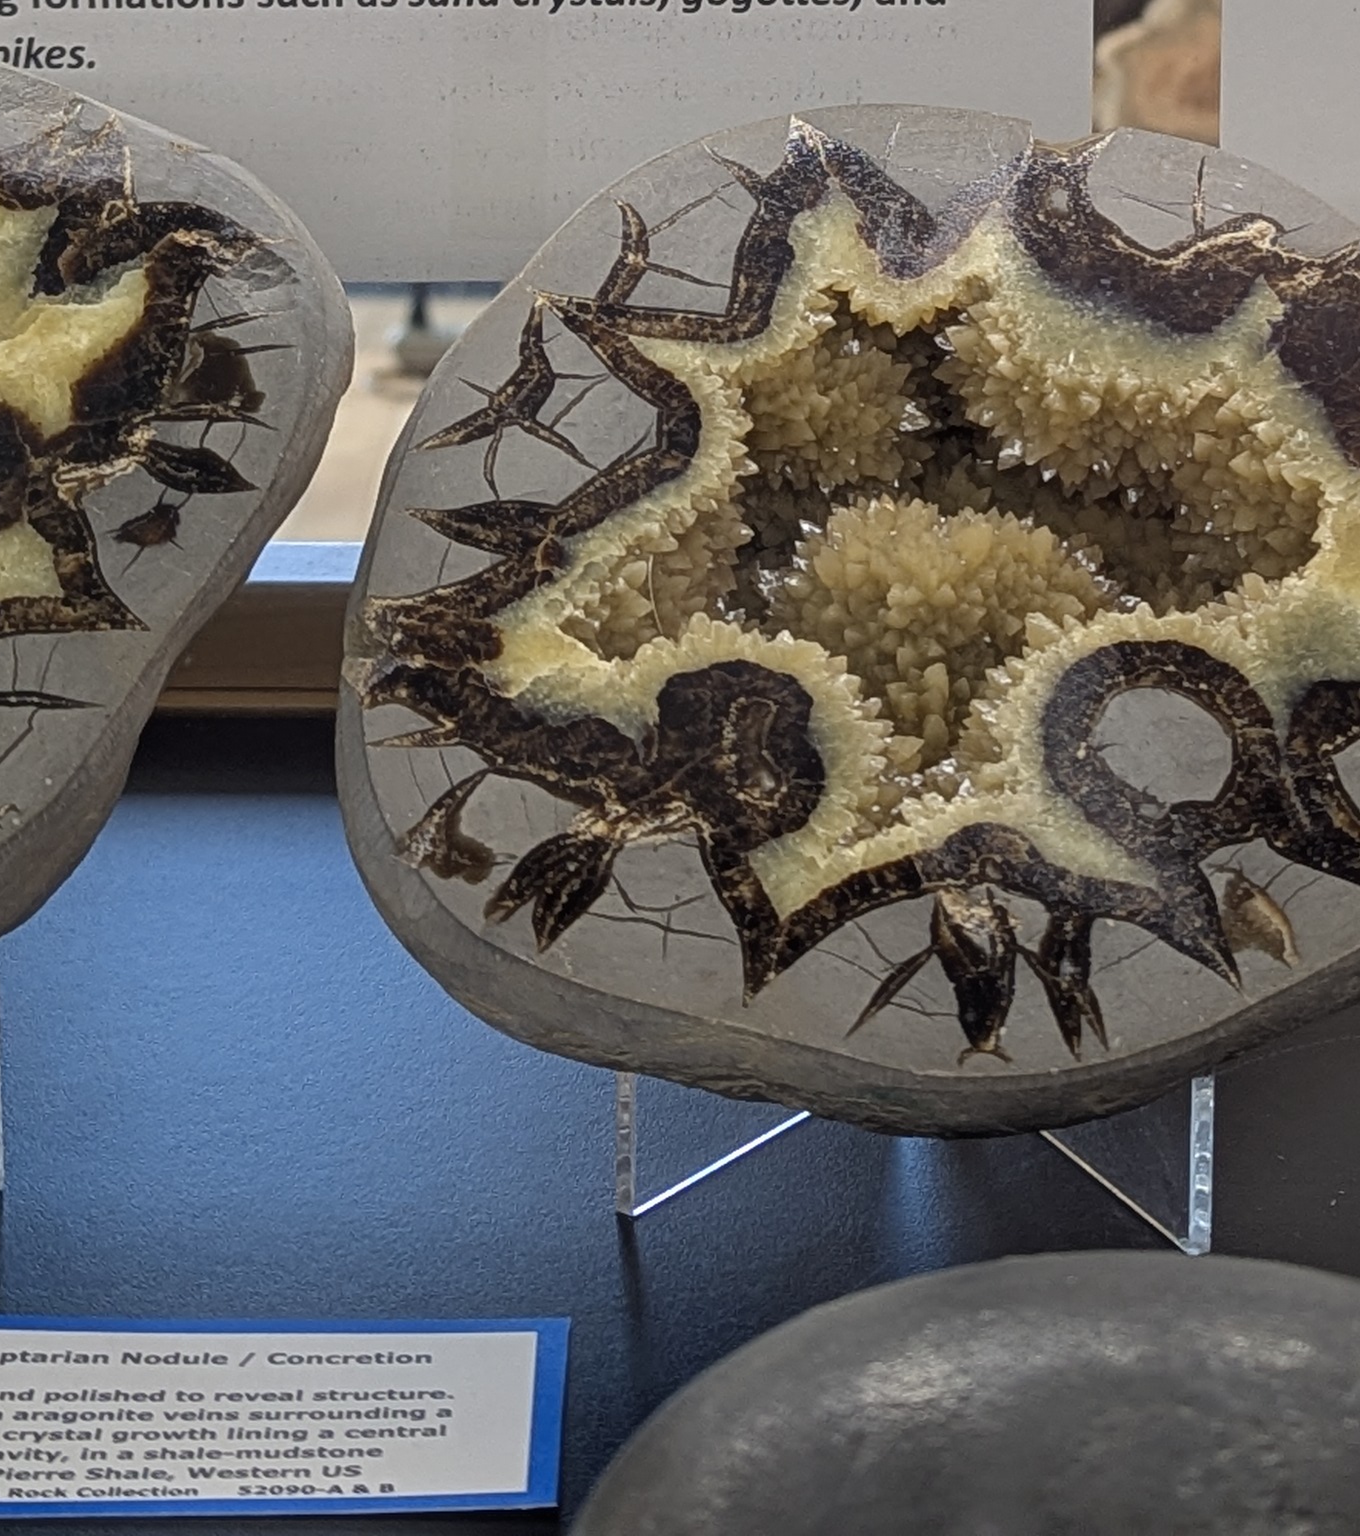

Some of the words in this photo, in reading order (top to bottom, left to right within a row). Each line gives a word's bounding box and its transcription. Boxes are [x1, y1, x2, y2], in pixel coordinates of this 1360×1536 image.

[122, 1353, 228, 1364] Nodule
[239, 1353, 254, 1367] /
[268, 1352, 431, 1364] Concretion
[44, 1390, 166, 1404] polished
[176, 1391, 204, 1402] to
[215, 1390, 303, 1401] reveal
[313, 1390, 454, 1401] structure.
[13, 1409, 153, 1423] aragonite
[164, 1409, 239, 1421] veins
[249, 1407, 425, 1421] surrounding
[436, 1409, 452, 1417] a
[3, 1428, 102, 1443] crystal
[112, 1428, 216, 1443] growth
[228, 1427, 308, 1441] lining
[318, 1430, 334, 1439] a
[345, 1425, 446, 1438] central
[81, 1448, 107, 1460] in
[117, 1451, 133, 1460] a
[144, 1447, 383, 1460] shale-mudstone
[85, 1467, 173, 1481] Shale,
[188, 1467, 310, 1479] Western
[323, 1465, 361, 1477] US
[8, 1488, 66, 1498] Rock
[77, 1487, 198, 1497] Collection
[380, 1484, 394, 1493] B
